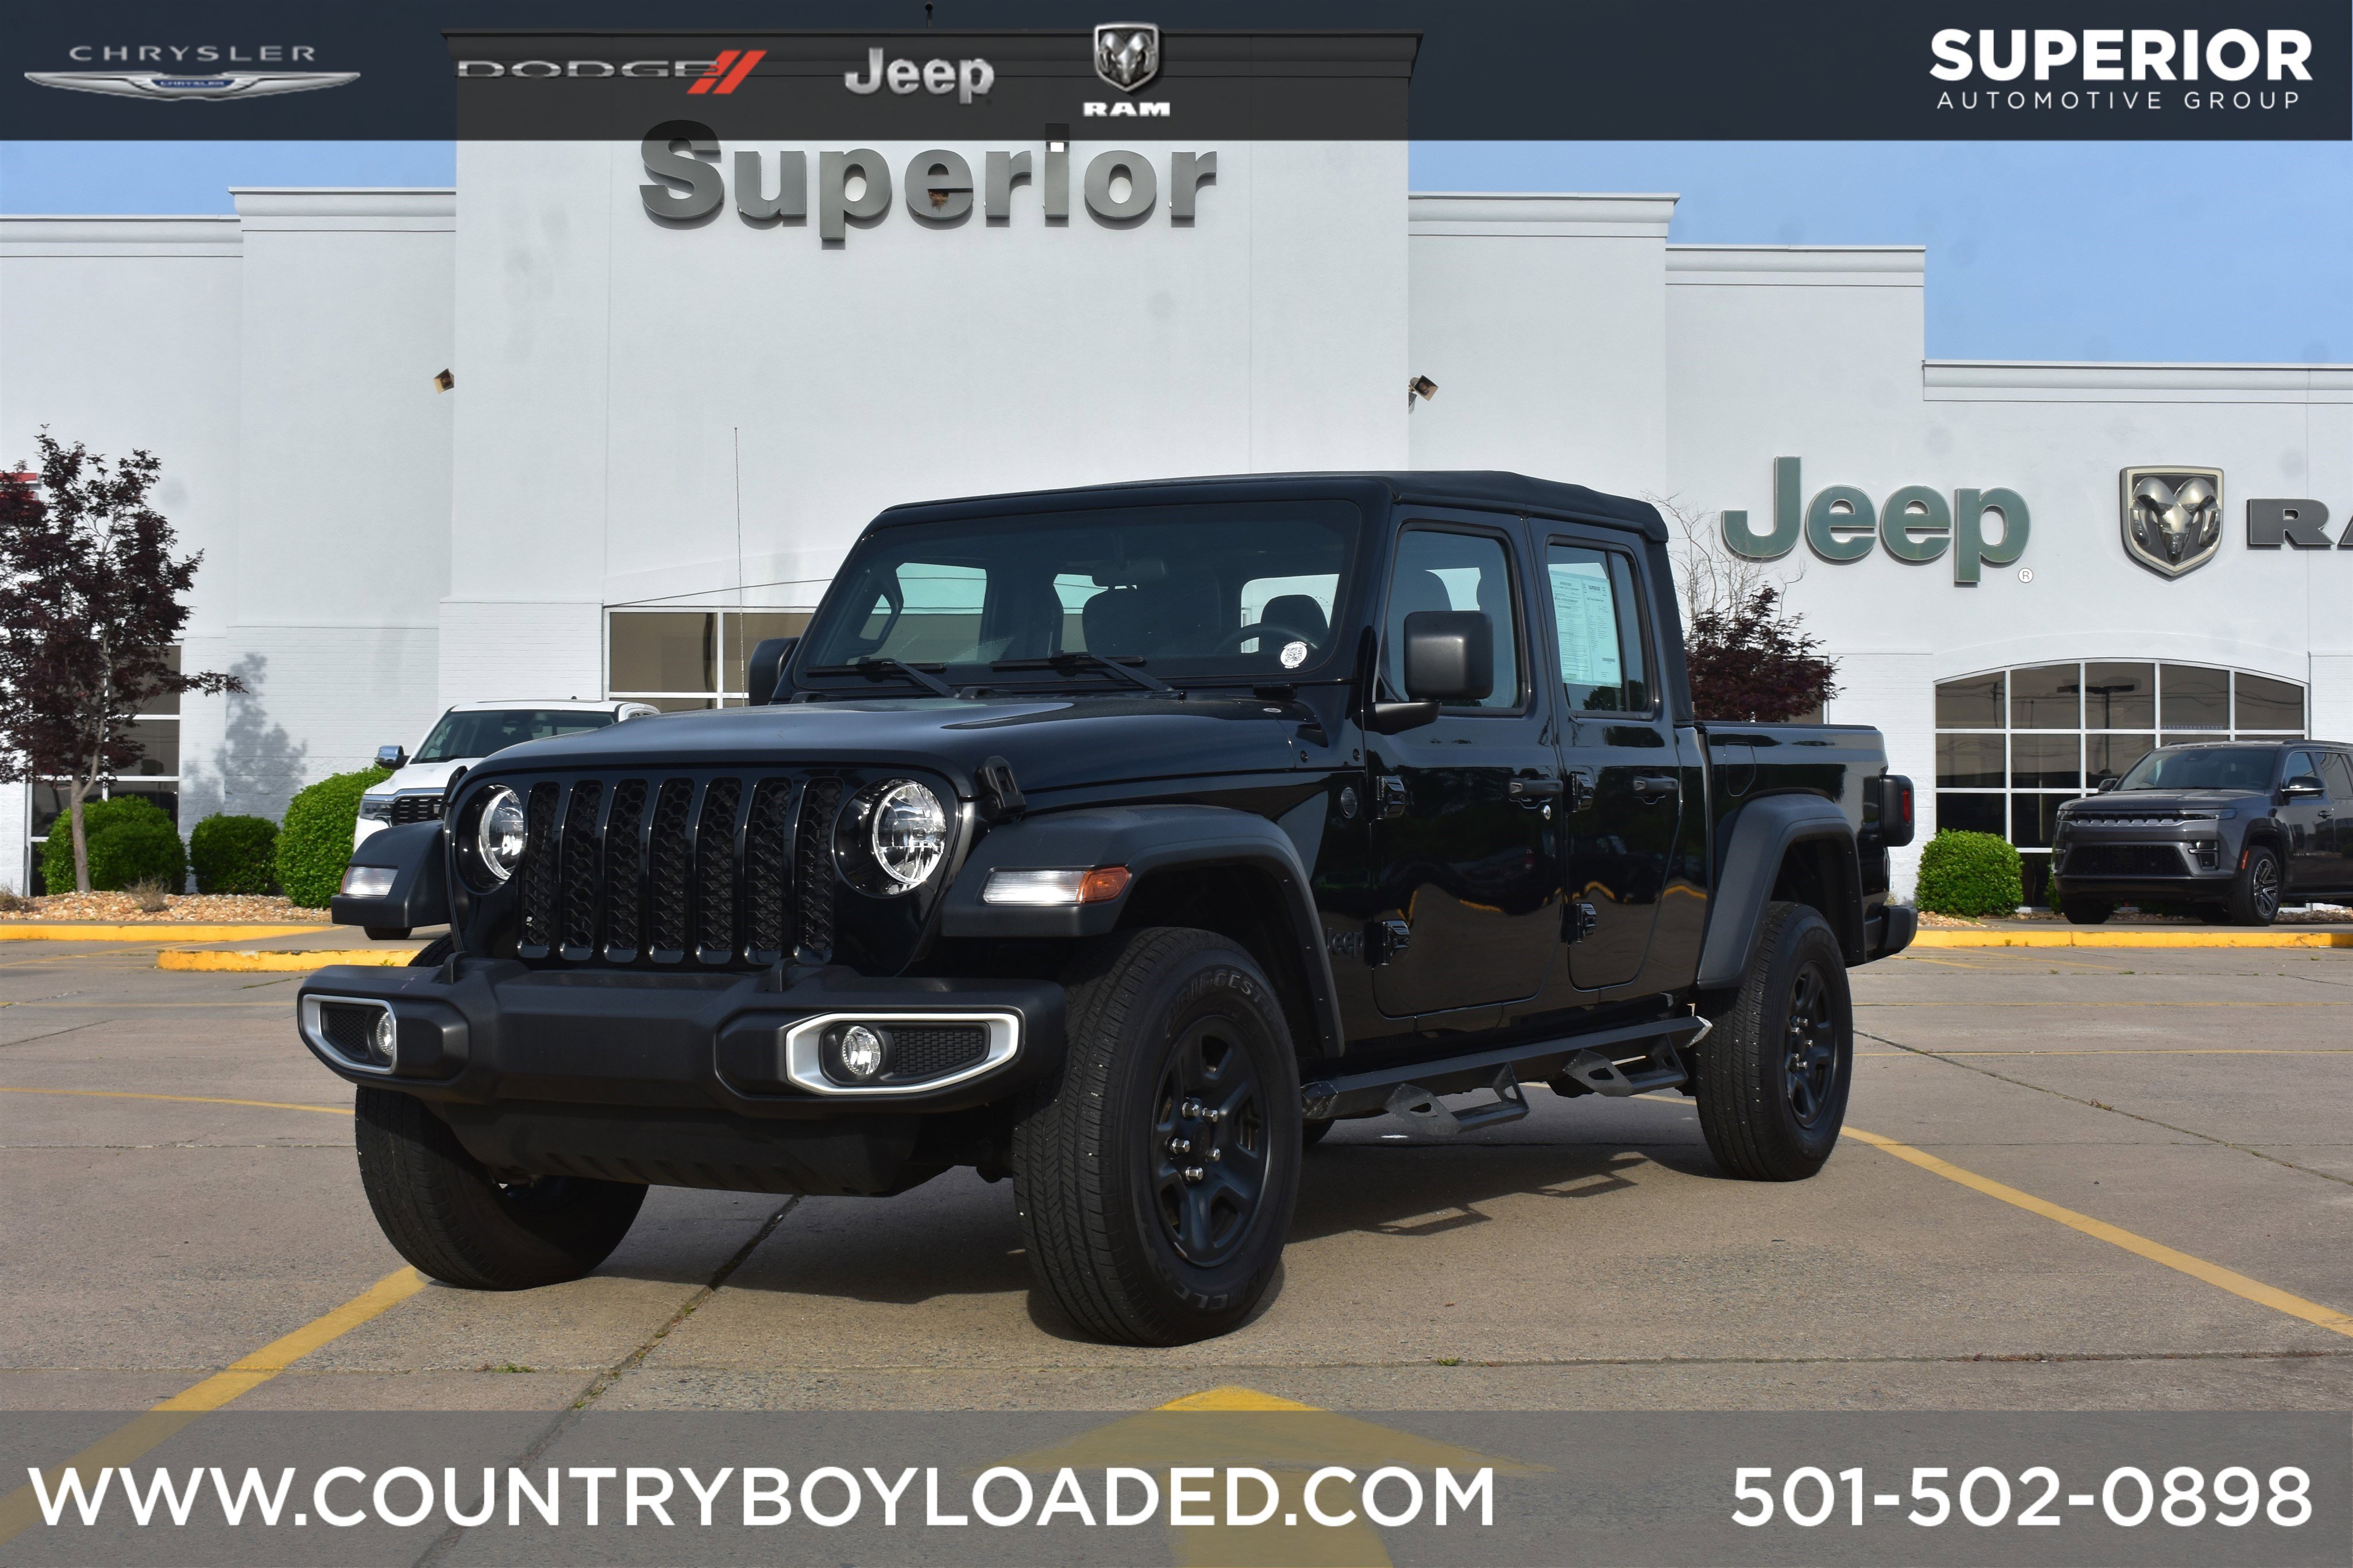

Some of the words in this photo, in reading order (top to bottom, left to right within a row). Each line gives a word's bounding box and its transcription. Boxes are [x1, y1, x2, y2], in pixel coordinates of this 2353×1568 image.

[639, 119, 1218, 240] Superior
[1722, 455, 2031, 583] Jeep
[1326, 927, 1363, 959] Jeep
